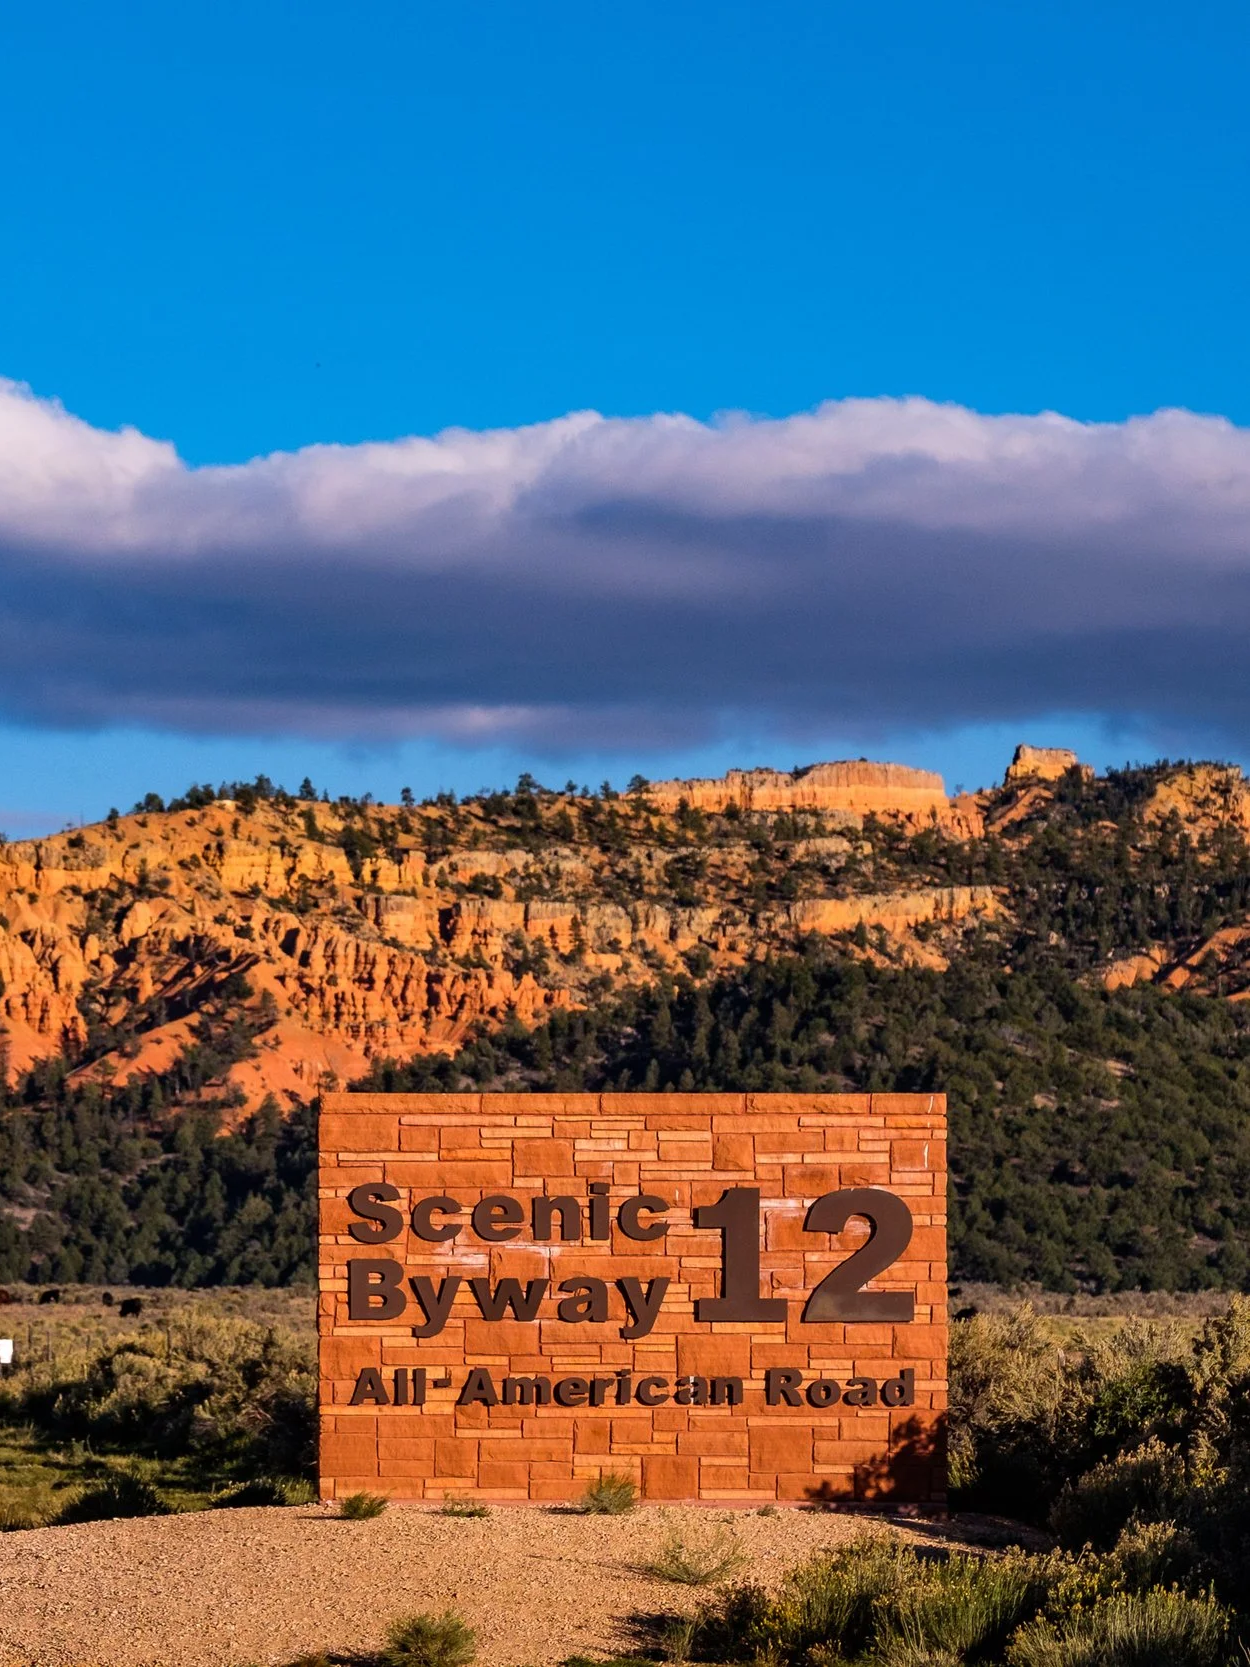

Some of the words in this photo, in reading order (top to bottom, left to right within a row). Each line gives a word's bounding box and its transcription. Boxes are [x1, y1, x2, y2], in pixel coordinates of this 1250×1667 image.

[348, 1182, 671, 1244] Scenic
[694, 1187, 915, 1323] 12
[348, 1258, 671, 1339] Byway
[350, 1367, 743, 1408] All-American
[765, 1368, 915, 1408] Road
